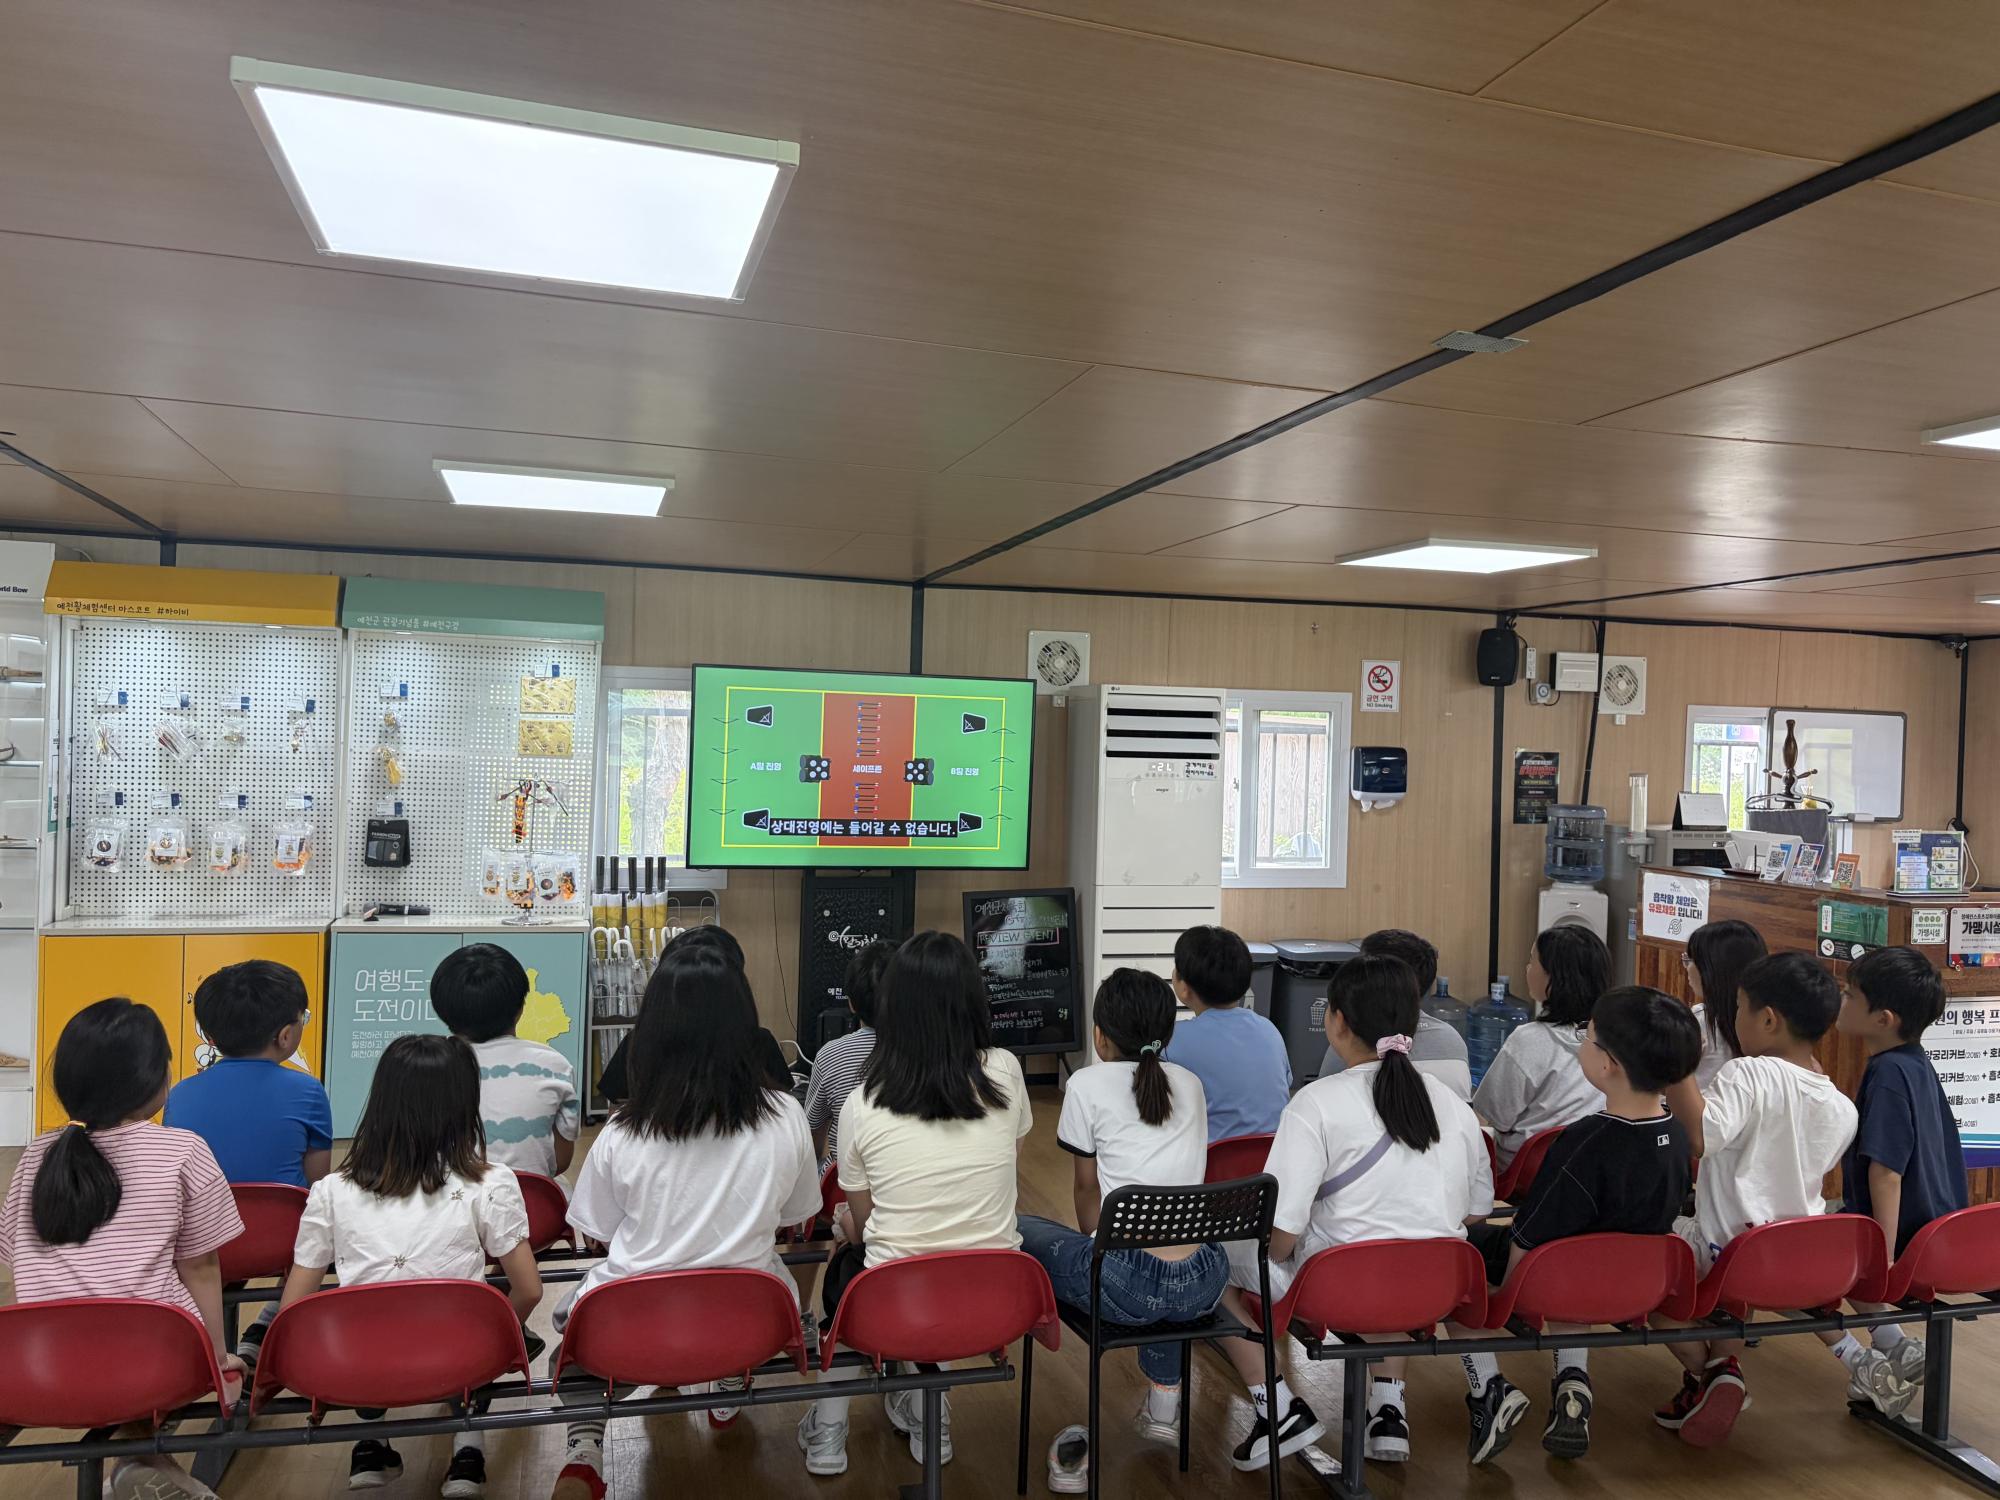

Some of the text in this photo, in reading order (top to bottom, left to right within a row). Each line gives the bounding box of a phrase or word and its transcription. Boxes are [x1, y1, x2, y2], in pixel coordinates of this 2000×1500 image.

[118, 606, 152, 614] 마스코트
[1366, 694, 1393, 703] 금연 구역
[750, 762, 782, 770] A팀 진영
[852, 764, 882, 774] 세이프존
[966, 768, 979, 776] 진영
[771, 820, 956, 836] 상대진영에는 들어갈 수 없습니다.
[1653, 892, 1698, 908] 흡착활 체험은
[1648, 903, 1702, 920] 유료체험 입니다!
[980, 930, 1054, 945] REVIEW EVENT
[1918, 929, 1940, 937] 가맹시설
[1962, 1010, 1986, 1026] 행복
